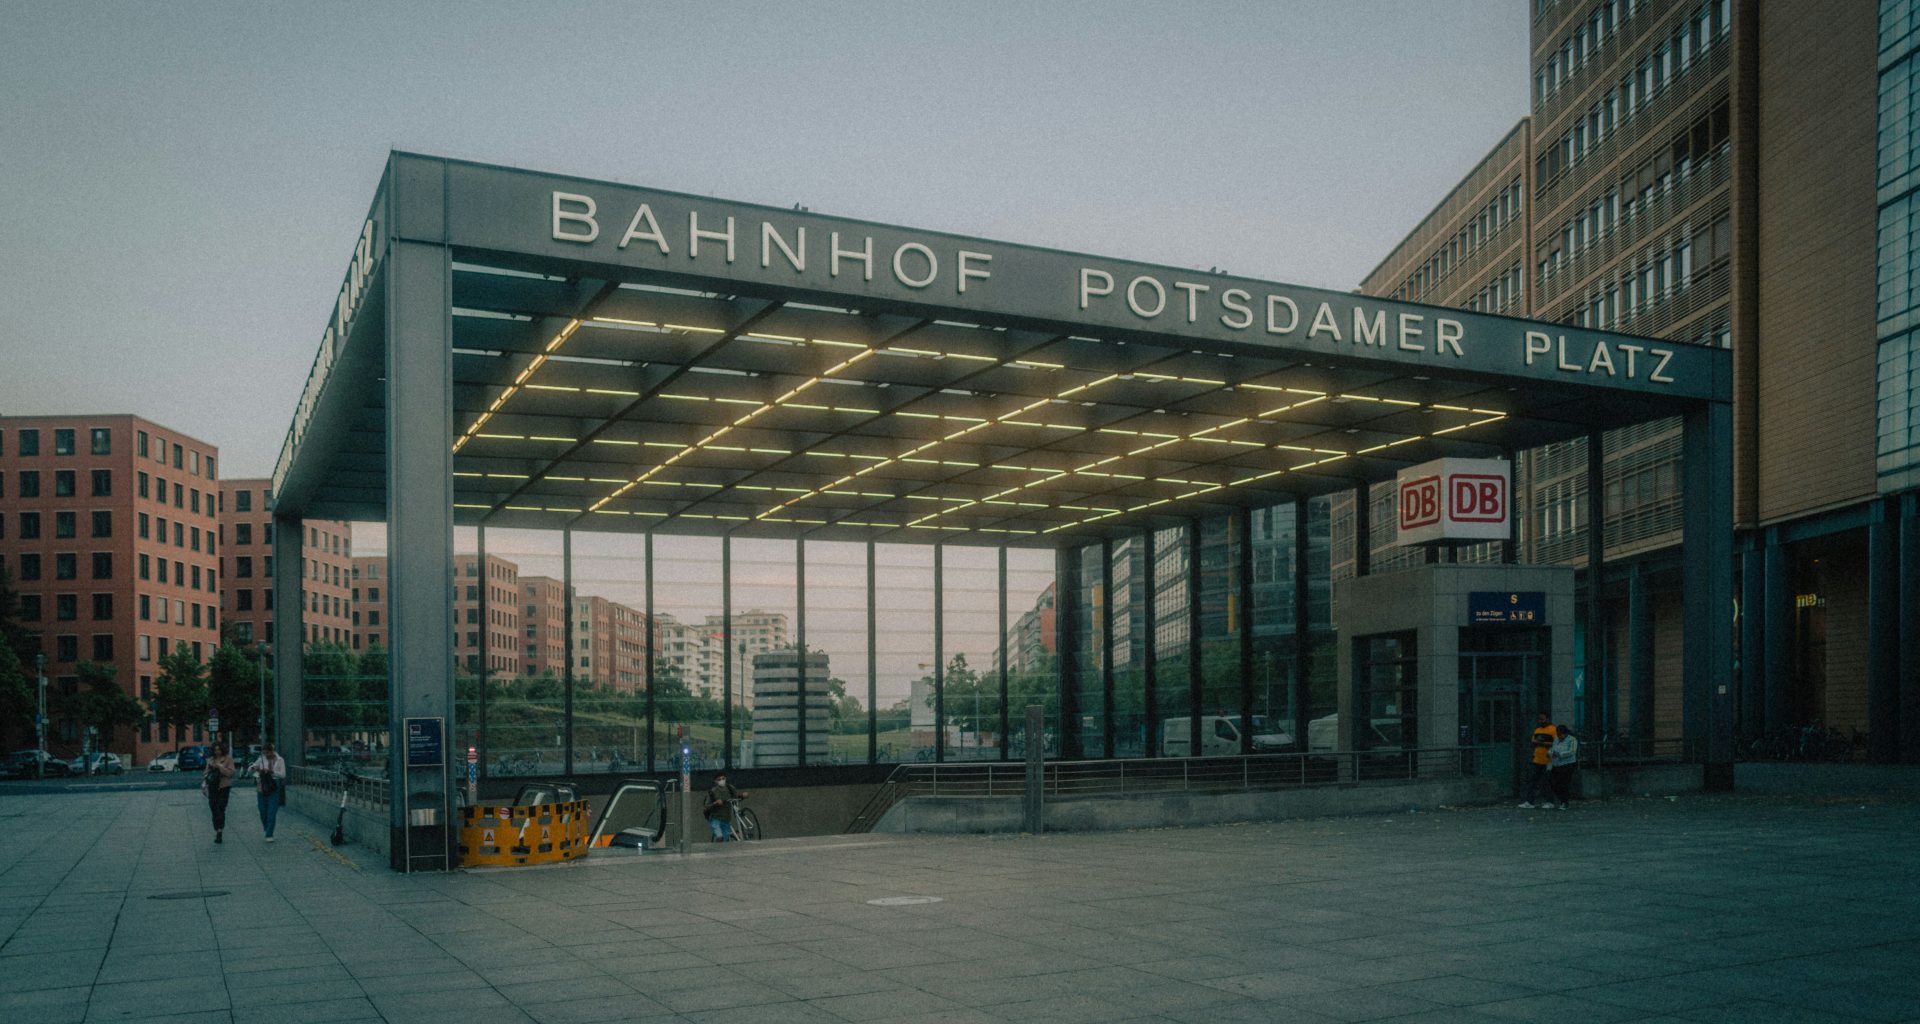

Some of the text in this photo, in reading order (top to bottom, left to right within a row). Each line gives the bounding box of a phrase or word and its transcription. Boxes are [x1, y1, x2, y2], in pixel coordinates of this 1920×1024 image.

[552, 191, 1674, 383] BAHNHOF POTSDAMER PLATZ
[1406, 485, 1436, 521] DB
[1456, 482, 1499, 514] DB
[1511, 594, 1518, 604] S
